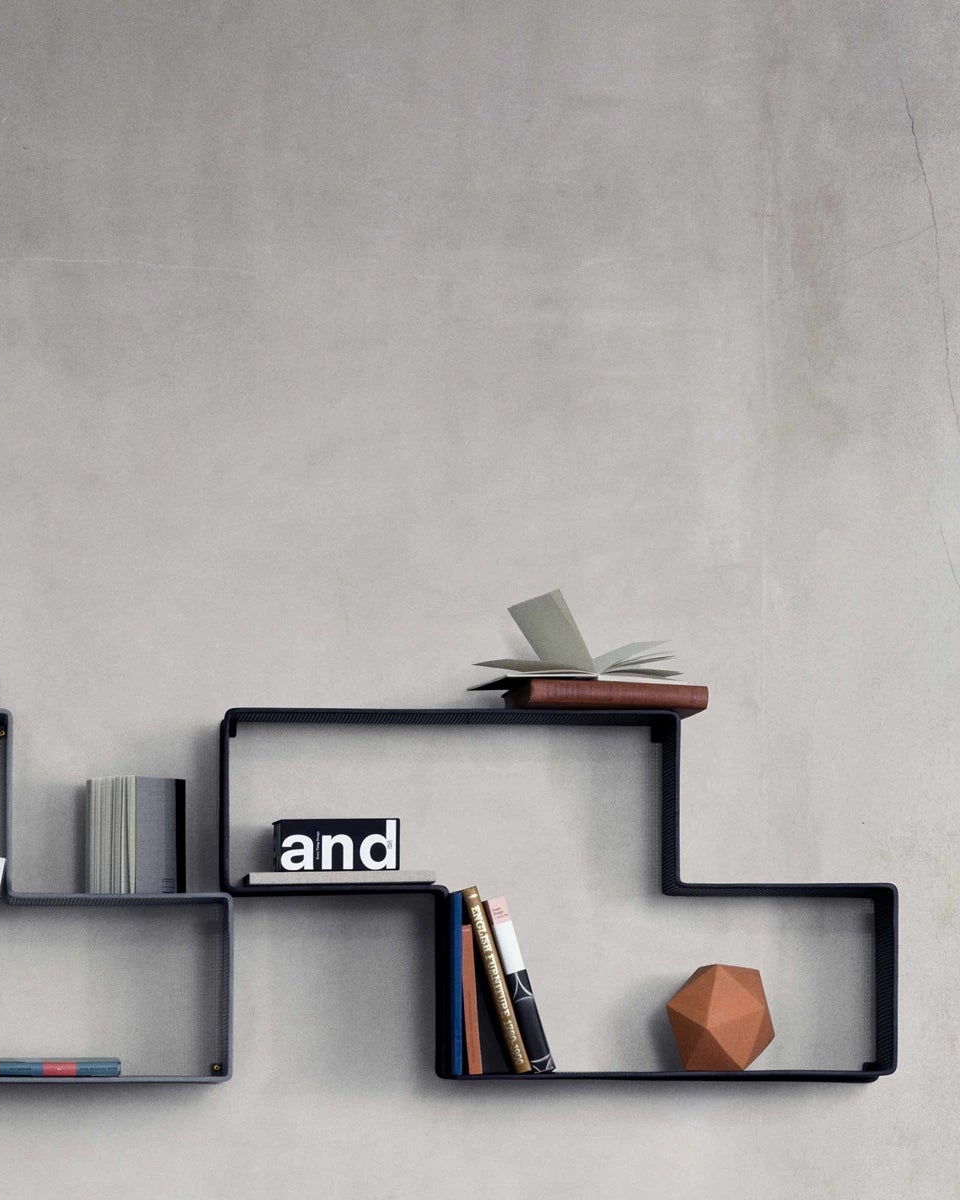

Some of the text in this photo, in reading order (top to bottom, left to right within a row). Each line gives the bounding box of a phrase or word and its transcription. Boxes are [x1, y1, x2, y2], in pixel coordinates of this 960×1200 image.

[280, 819, 397, 871] and
[470, 904, 493, 953] ENGLISH
[484, 953, 510, 1017] FURNITURE
